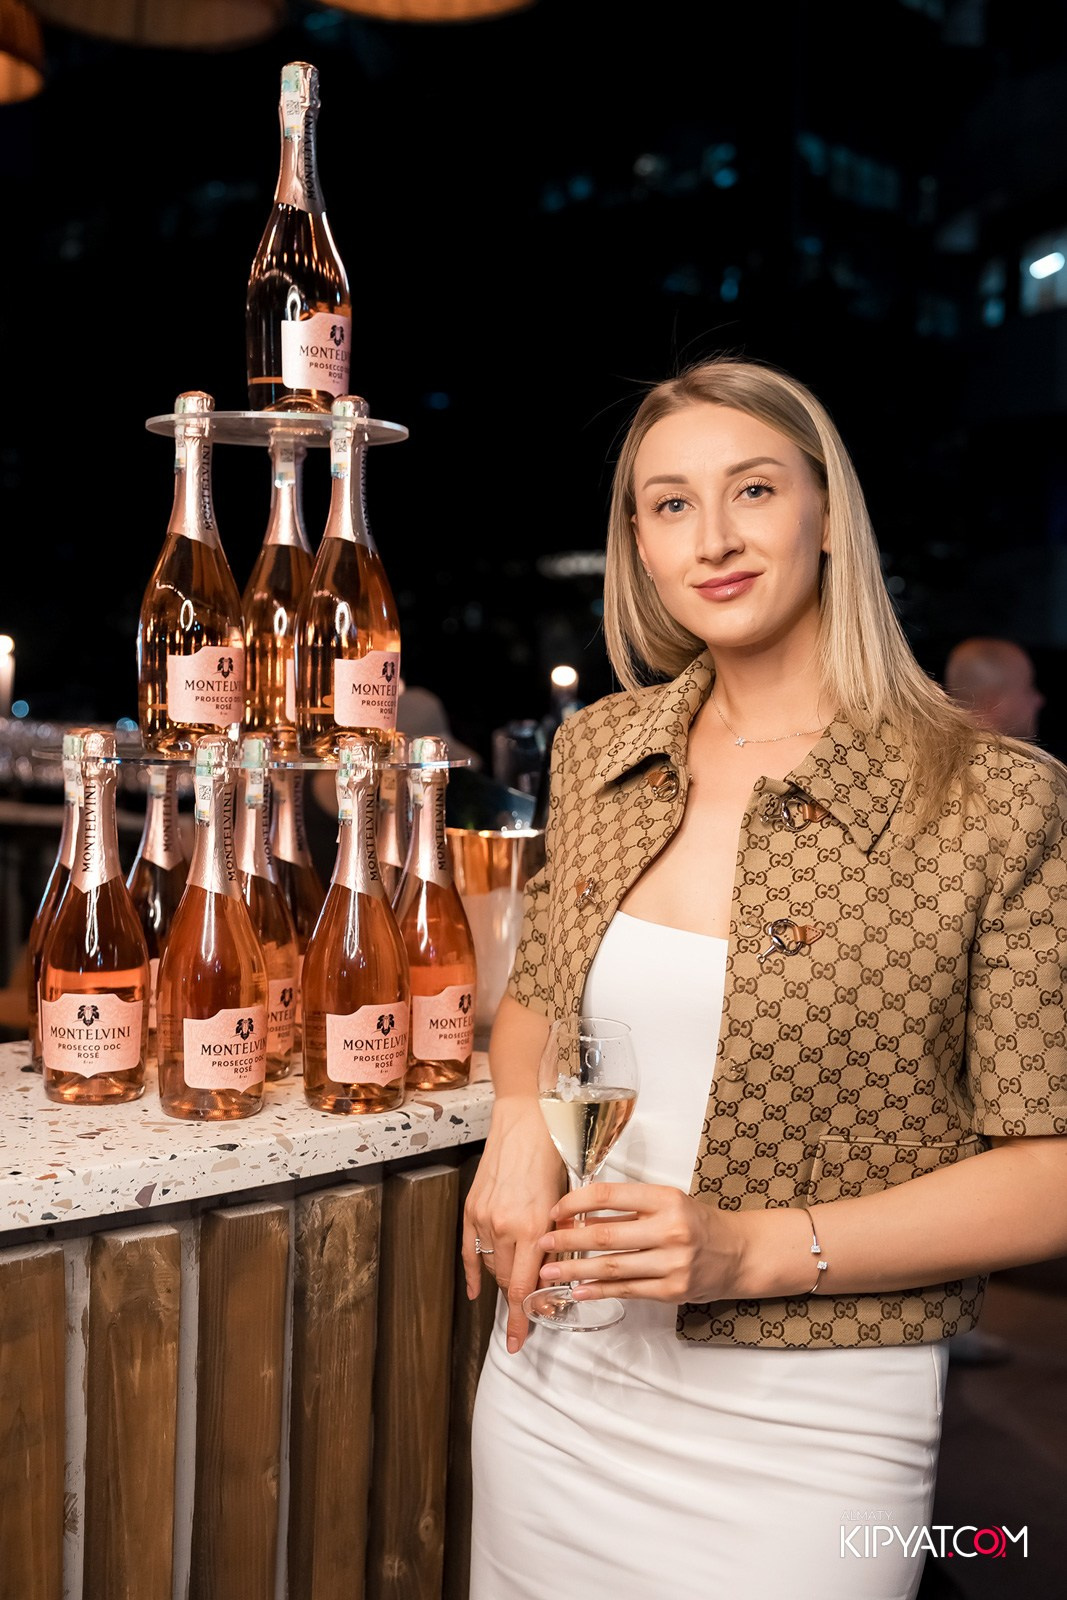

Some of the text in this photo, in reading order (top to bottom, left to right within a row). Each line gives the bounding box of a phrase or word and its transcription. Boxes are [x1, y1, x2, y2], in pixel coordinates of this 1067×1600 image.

[195, 695, 233, 703] PROSECCO
[82, 784, 97, 873] MONTELVINI
[435, 787, 447, 871] MONTELVINI
[223, 791, 237, 881] MONTELVINI
[366, 792, 379, 881] MONTELVINI
[50, 1025, 131, 1041] MONTELVINI
[57, 1042, 121, 1051] PROSECCO DOC
[77, 1051, 100, 1059] ROSÉ
[353, 1053, 395, 1062] PROSECCO
[211, 1059, 254, 1067] PROSECCO
